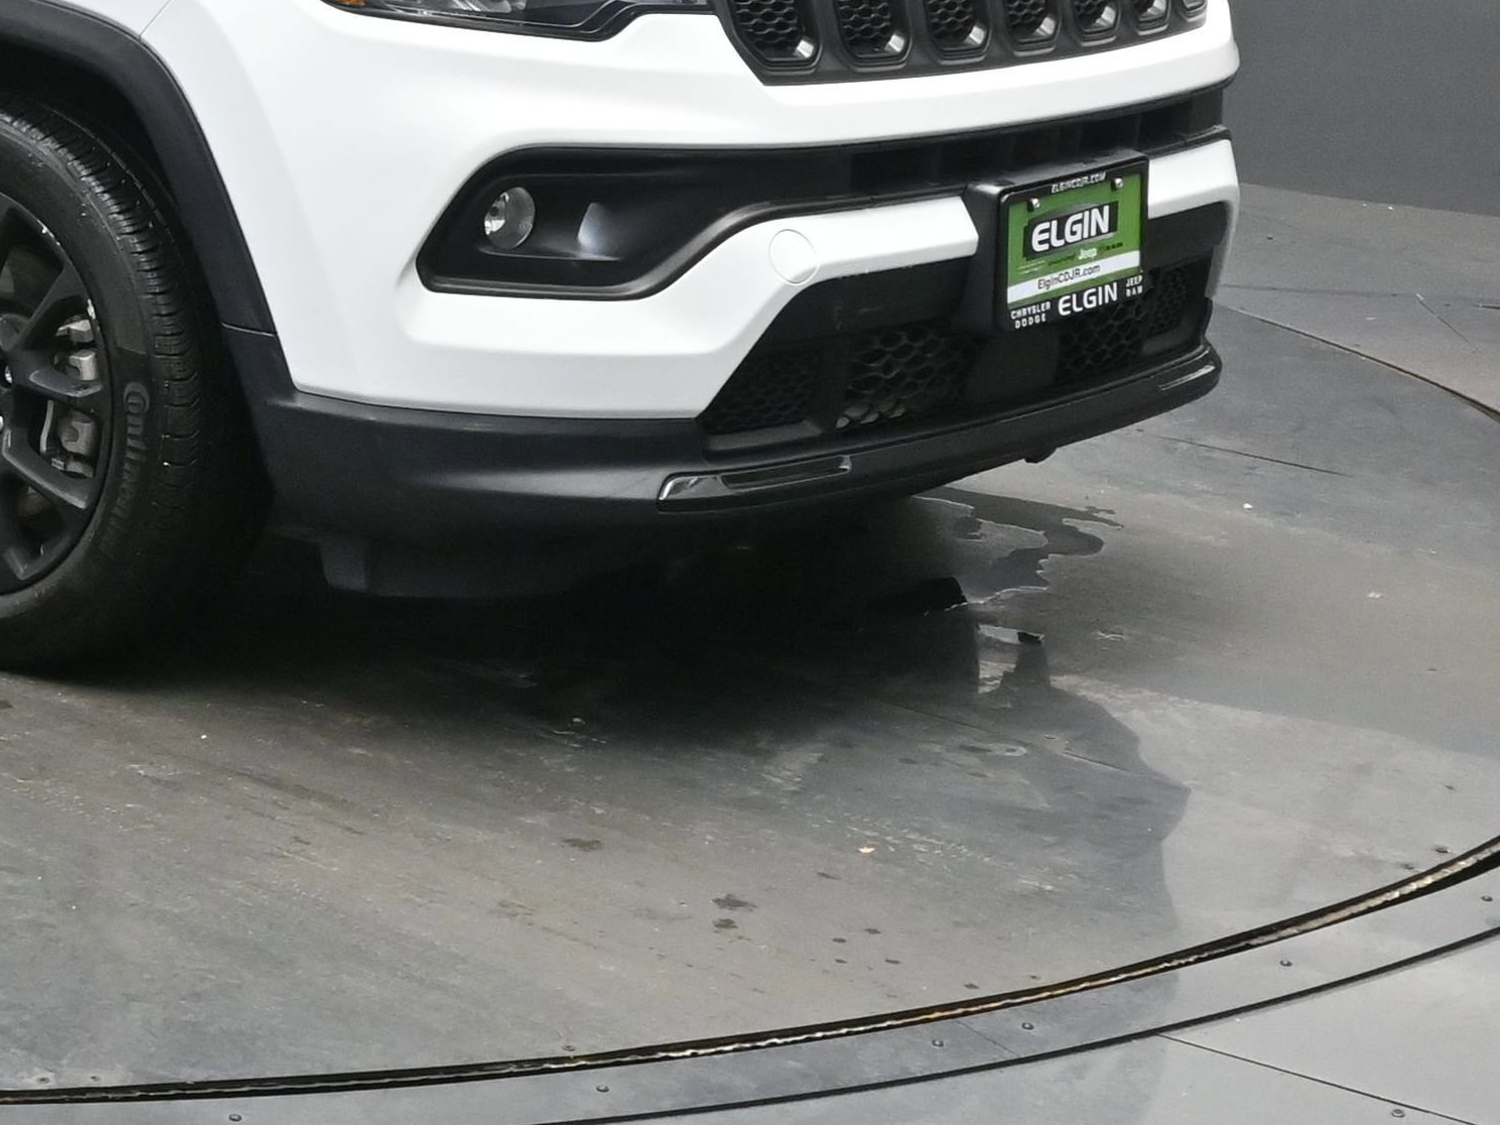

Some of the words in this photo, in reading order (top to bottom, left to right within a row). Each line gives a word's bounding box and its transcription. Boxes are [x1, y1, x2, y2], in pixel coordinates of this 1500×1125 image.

[1032, 204, 1110, 252] ELGIN
[1037, 265, 1101, 290] ElginCDJR.com
[1126, 275, 1143, 288] JEEP
[1058, 282, 1118, 316] ELGIN
[1010, 301, 1051, 321] CHRYSLER
[1014, 313, 1047, 329] DODGE
